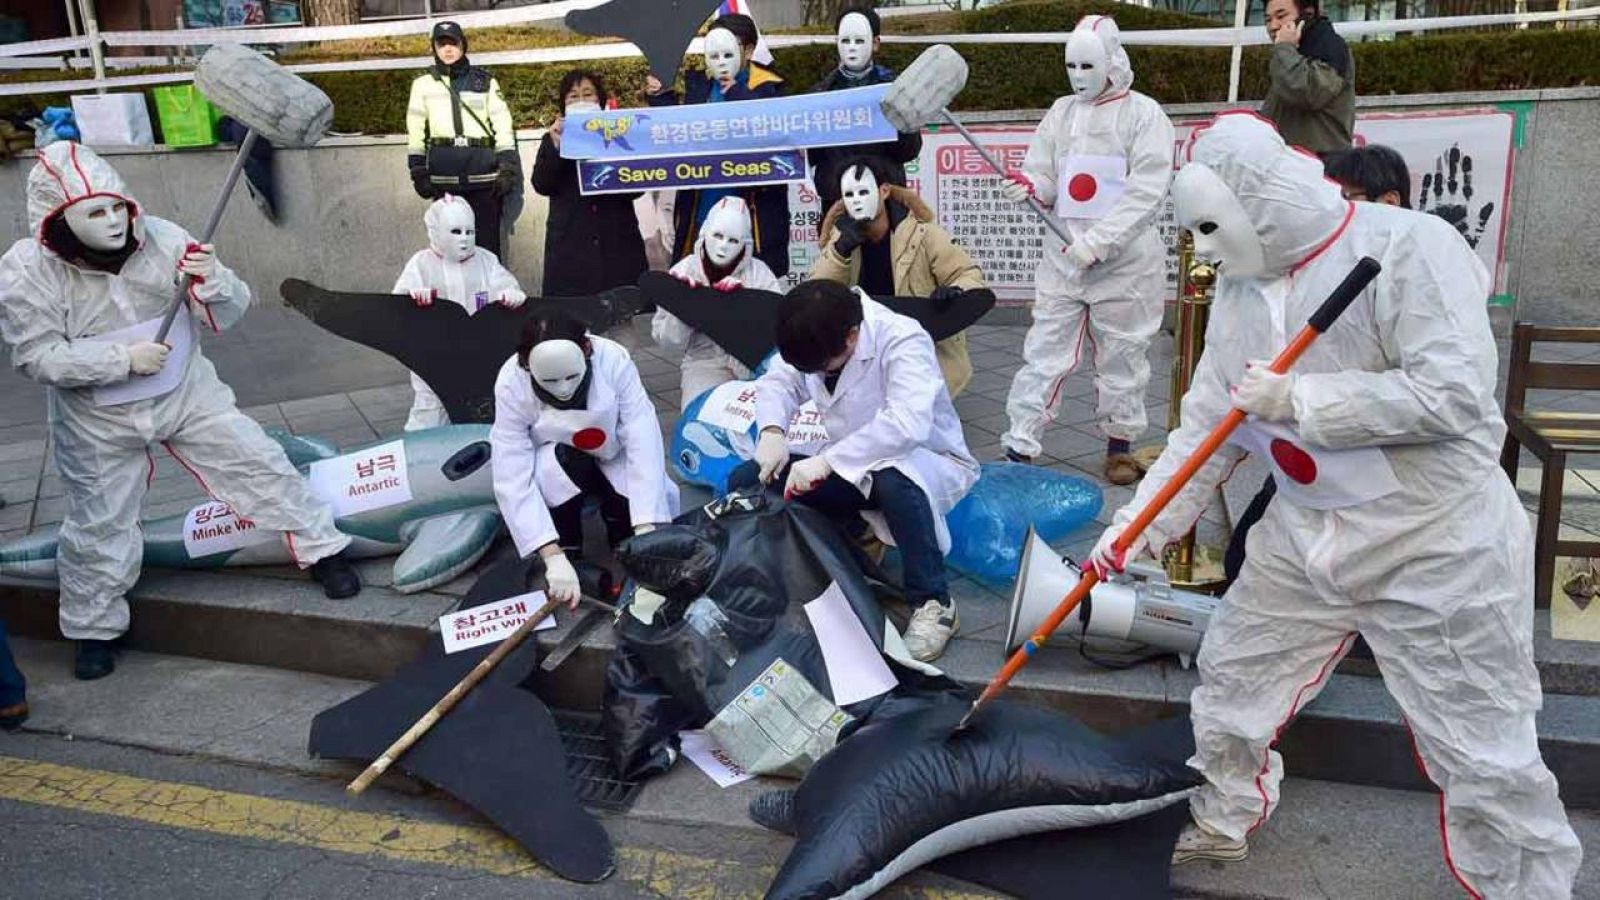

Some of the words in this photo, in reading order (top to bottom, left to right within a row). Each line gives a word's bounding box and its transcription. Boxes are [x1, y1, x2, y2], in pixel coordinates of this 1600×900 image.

[617, 166, 668, 183] Save
[675, 163, 713, 179] Our
[720, 160, 772, 177] Seas
[356, 454, 396, 478] 남극
[348, 477, 401, 497] Antartic
[192, 523, 232, 541] Minke
[453, 601, 527, 630] 참고래
[456, 624, 497, 641] Right
